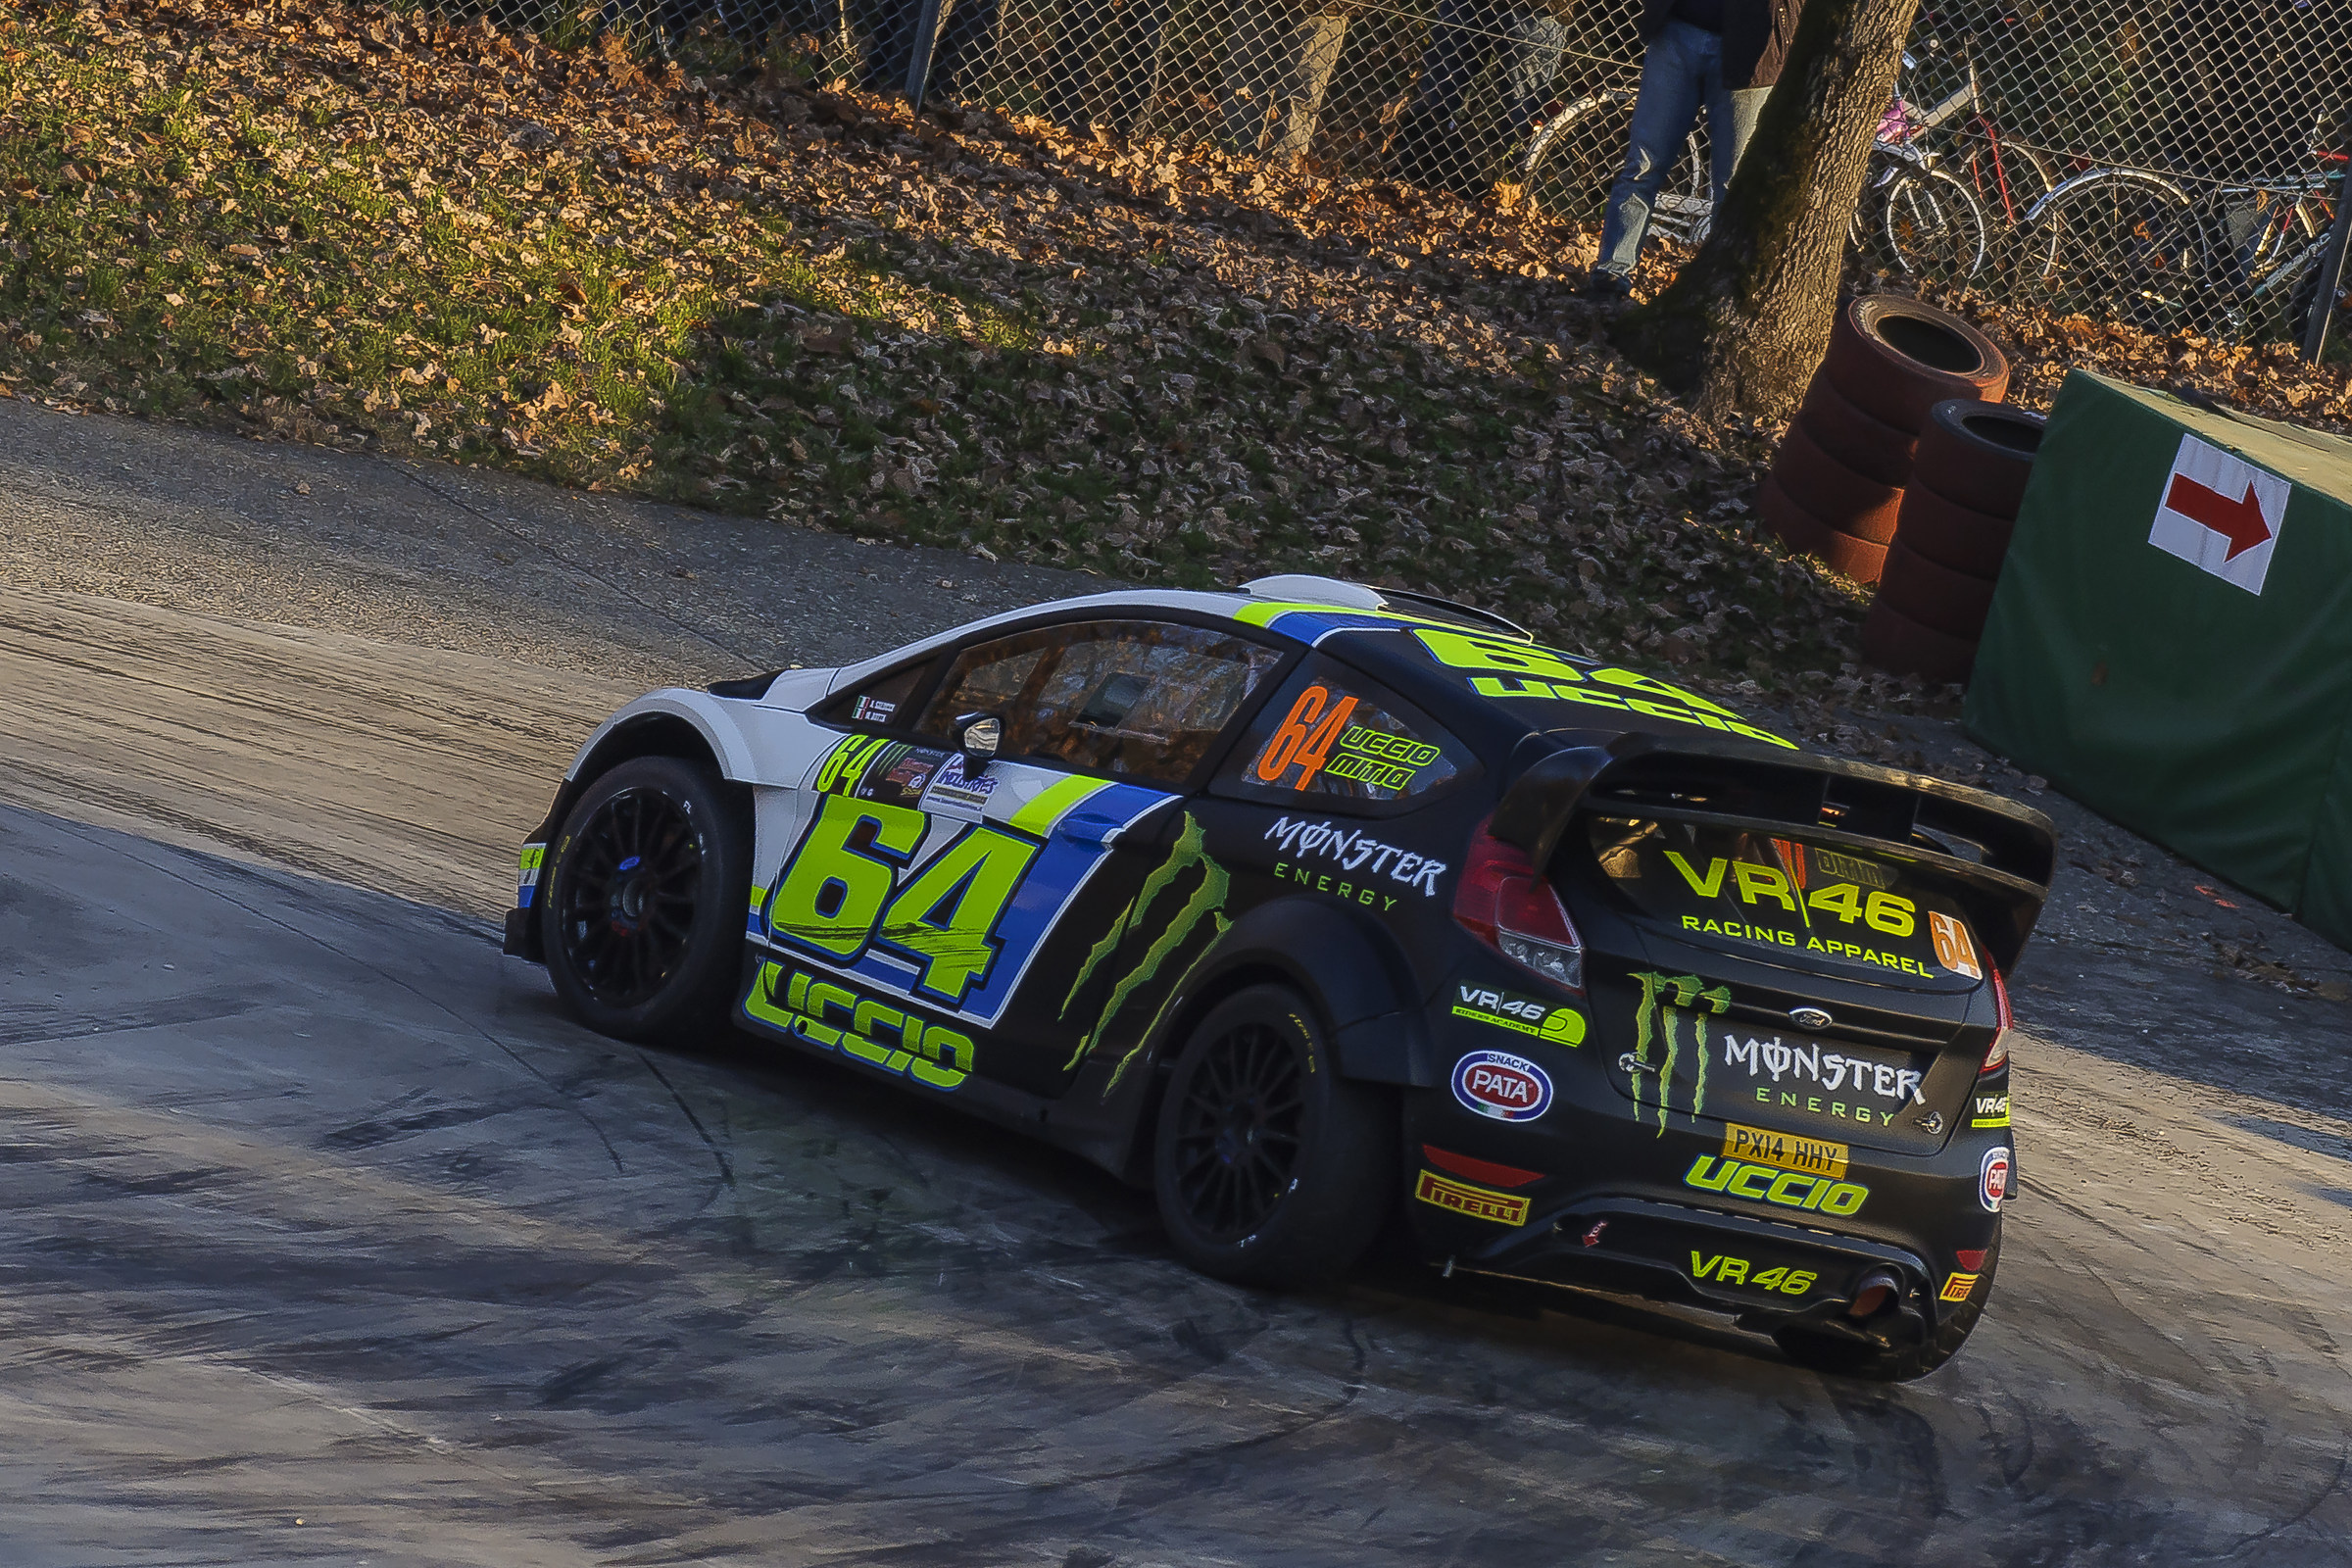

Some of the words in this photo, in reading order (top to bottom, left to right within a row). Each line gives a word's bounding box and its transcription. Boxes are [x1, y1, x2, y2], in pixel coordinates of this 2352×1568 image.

[1257, 685, 1359, 792] 64
[1470, 676, 1800, 751] UCCIO
[817, 734, 890, 797] 64
[1340, 725, 1441, 767] UCCIO
[771, 794, 1040, 1000] 64
[1274, 861, 1397, 911] ENERGY
[1682, 915, 1796, 948] RACING
[1806, 936, 1935, 979] APPAREL
[1928, 910, 1978, 977] 64
[742, 959, 974, 1093] UCCIO
[1472, 1069, 1528, 1103] PATA
[1755, 1087, 1895, 1128] ENERGY
[1684, 1154, 1870, 1216] UCCIO
[1791, 1140, 1838, 1171] HHY
[1421, 1174, 1525, 1222] PIRELLI
